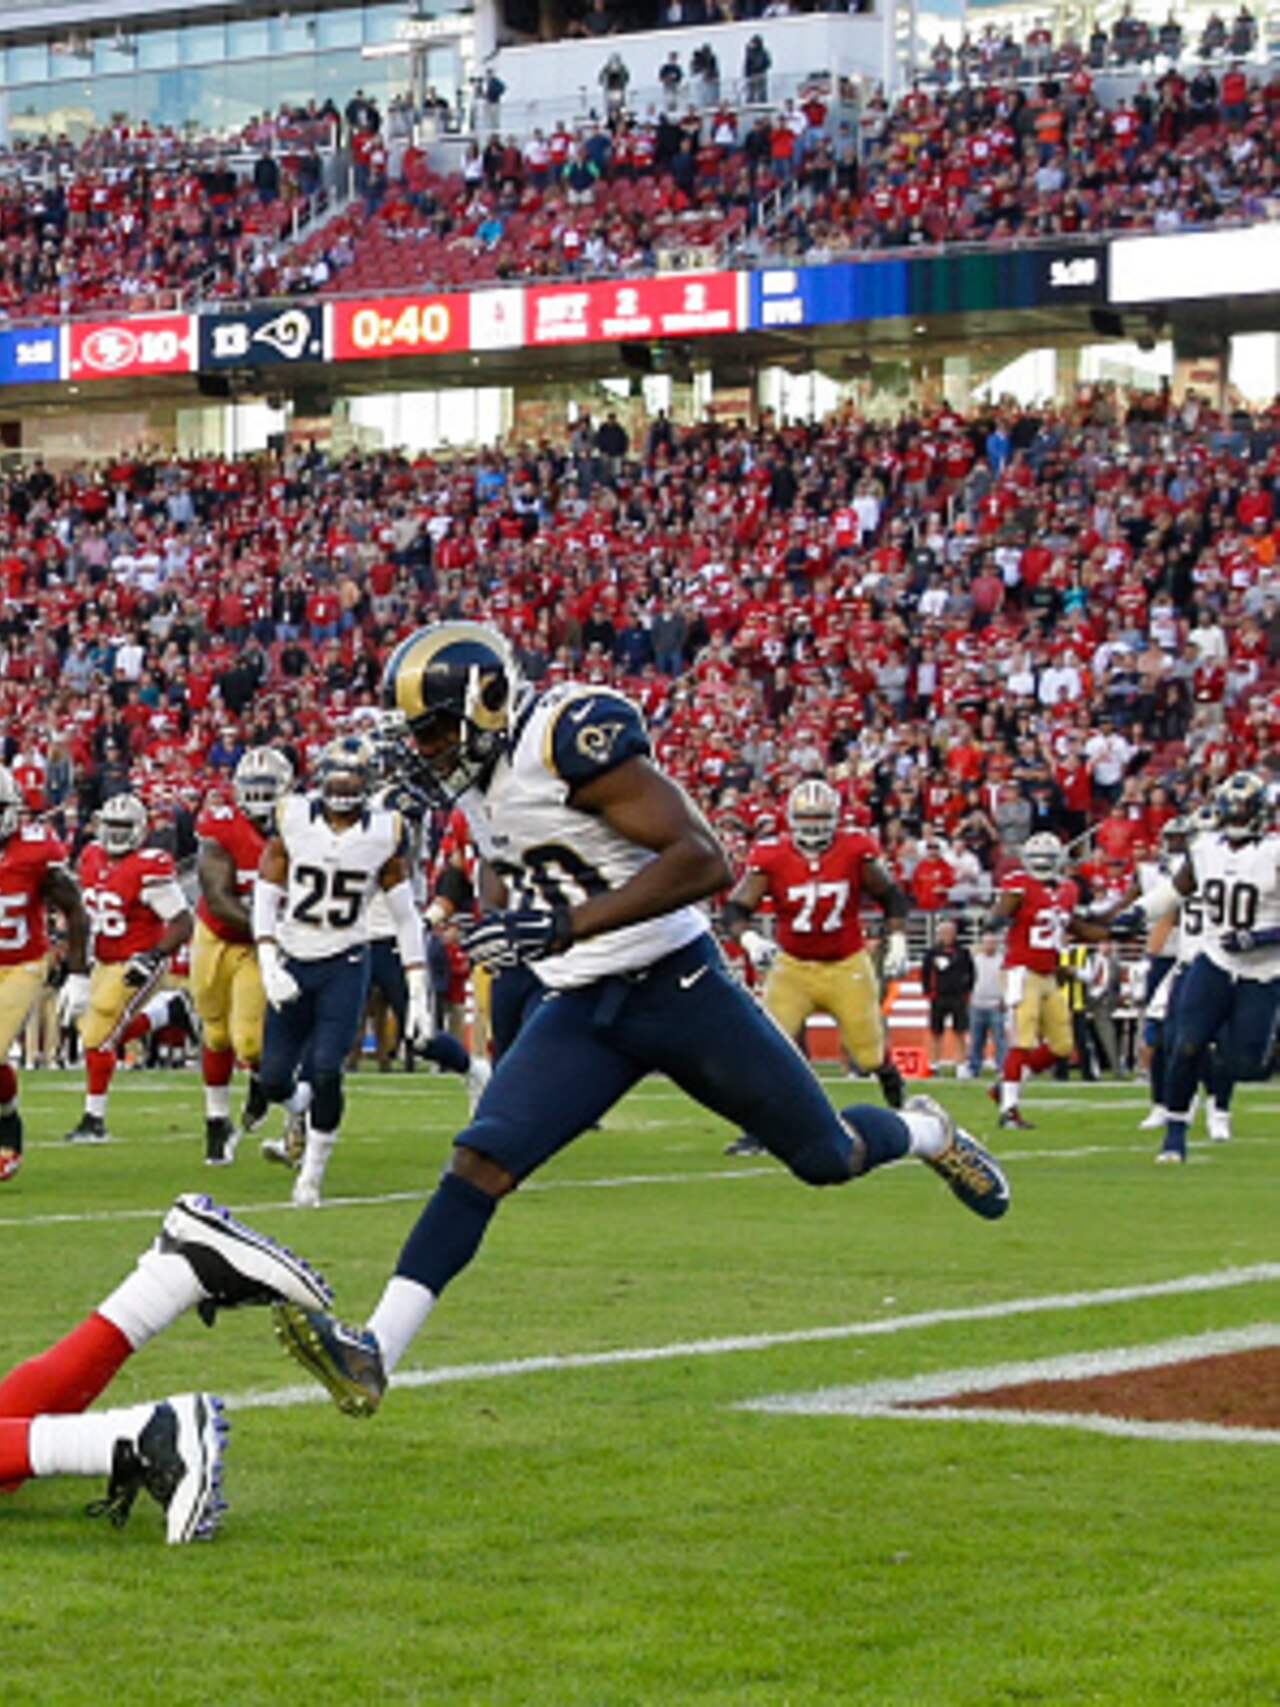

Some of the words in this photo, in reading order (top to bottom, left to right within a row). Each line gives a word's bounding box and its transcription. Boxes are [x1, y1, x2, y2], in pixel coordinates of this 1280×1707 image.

[352, 303, 451, 350] 0:40
[292, 865, 369, 928] 25
[787, 879, 850, 932] 77
[1203, 878, 1260, 930] 90
